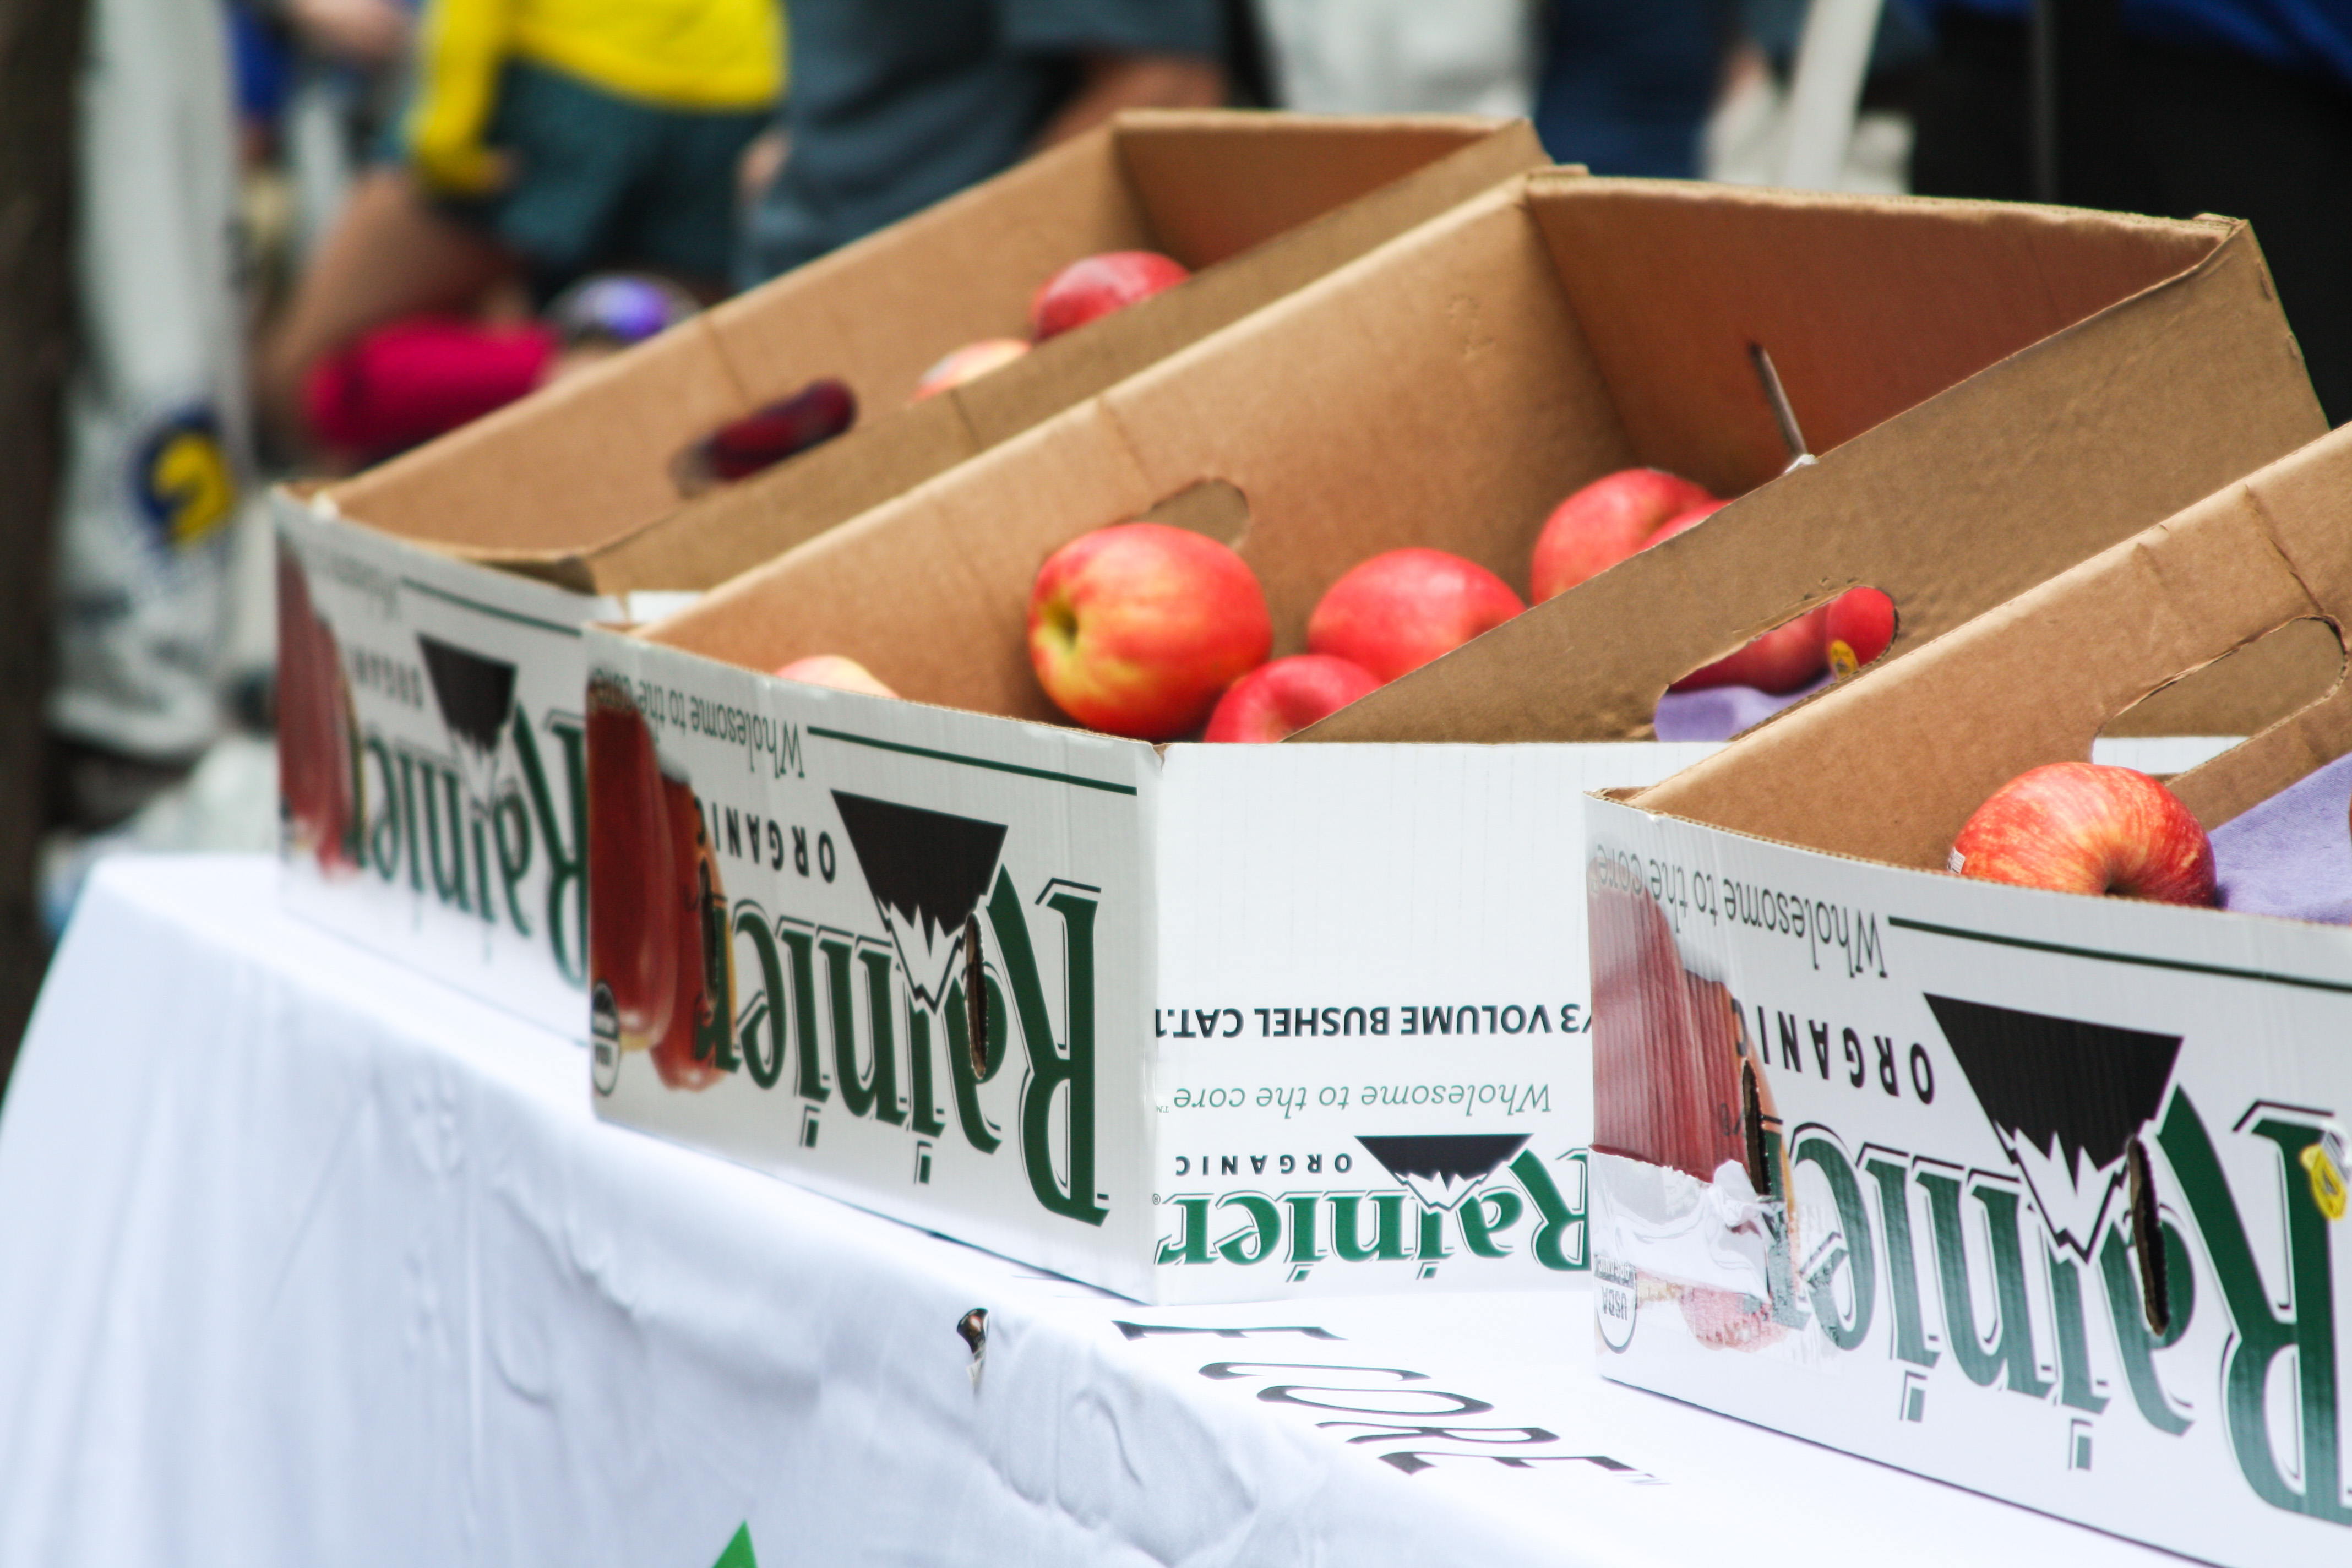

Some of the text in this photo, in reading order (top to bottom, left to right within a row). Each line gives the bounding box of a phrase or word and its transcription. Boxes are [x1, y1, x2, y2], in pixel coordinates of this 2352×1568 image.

[639, 679, 667, 747] the
[669, 690, 687, 733] to
[691, 696, 805, 779] Wholesome
[693, 795, 837, 884] ORGANIC
[1649, 858, 1689, 934] the
[1692, 871, 1719, 927] to
[1723, 876, 1888, 979] Wholesome
[1155, 1008, 1245, 1039] CAT.1
[1254, 1005, 1391, 1037] BUSHEL
[1401, 1004, 1554, 1036] VOLUME
[692, 862, 1112, 1228] Rainier
[1732, 997, 1935, 1105] ORGANIC
[1256, 1086, 1308, 1119] the
[1318, 1086, 1350, 1111] to
[1360, 1083, 1553, 1117] Wholesome
[1174, 1153, 1353, 1176] ORGANIC
[1602, 1286, 1628, 1321] USDA
